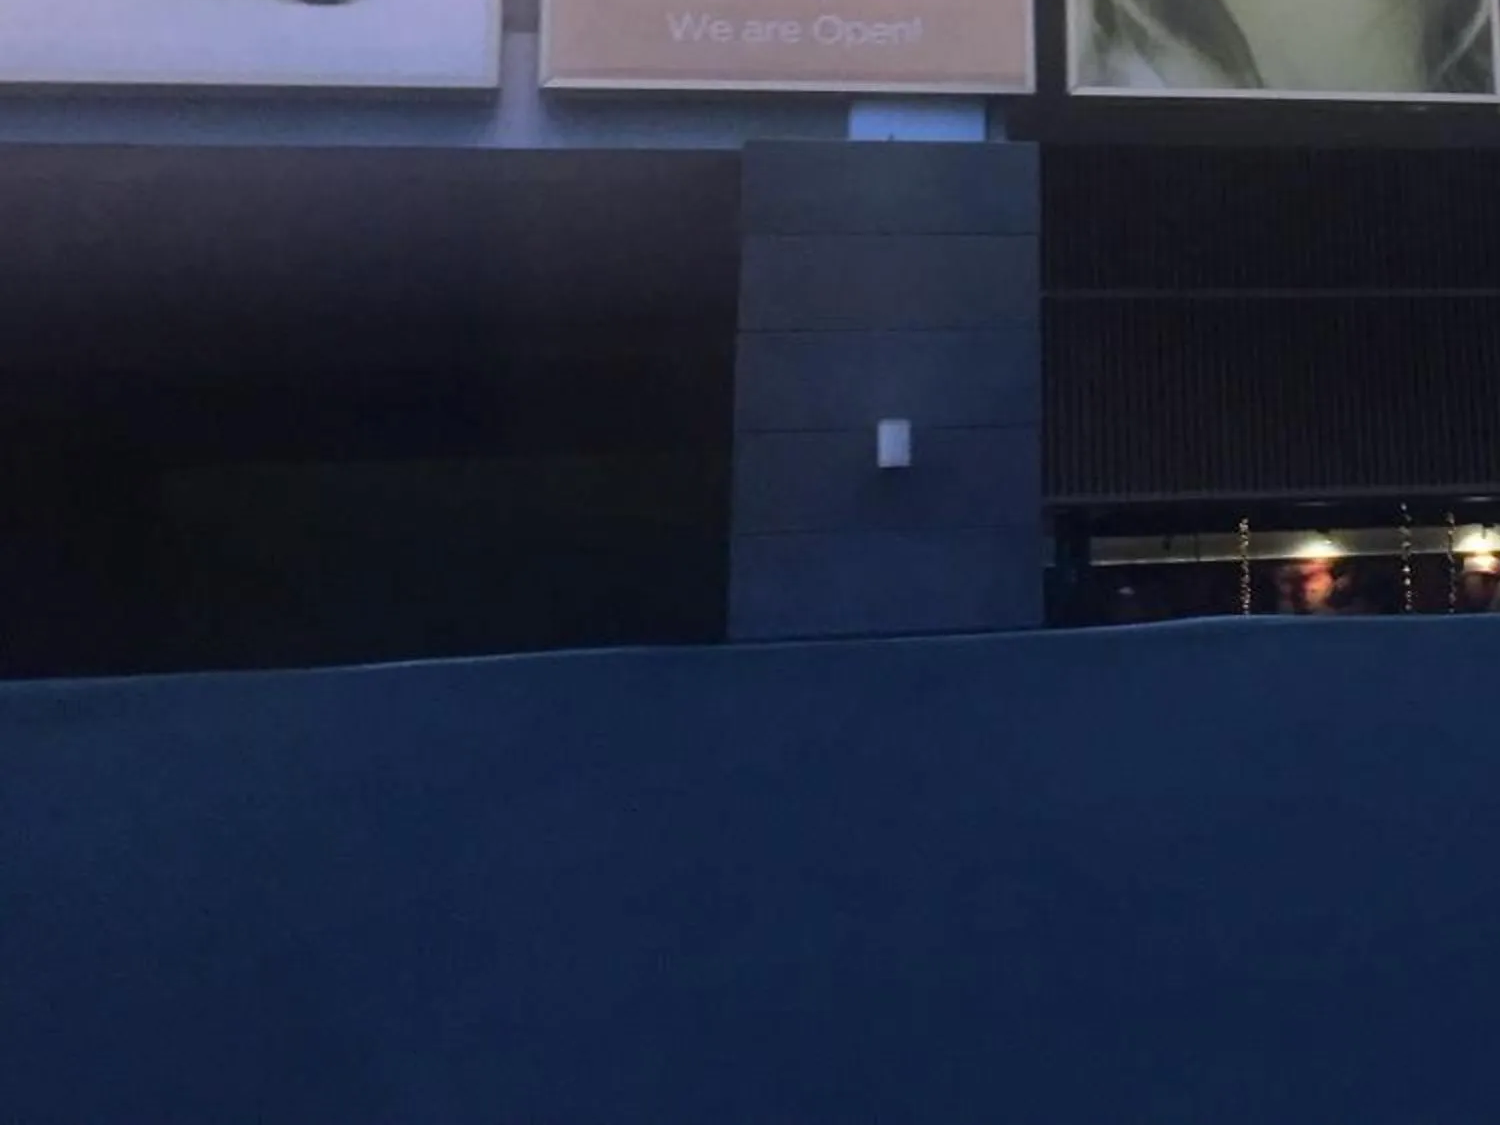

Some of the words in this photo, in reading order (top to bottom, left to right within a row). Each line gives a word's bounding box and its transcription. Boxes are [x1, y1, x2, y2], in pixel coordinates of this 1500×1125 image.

[664, 10, 733, 43] We
[741, 18, 802, 44] are
[813, 13, 925, 48] Open!
